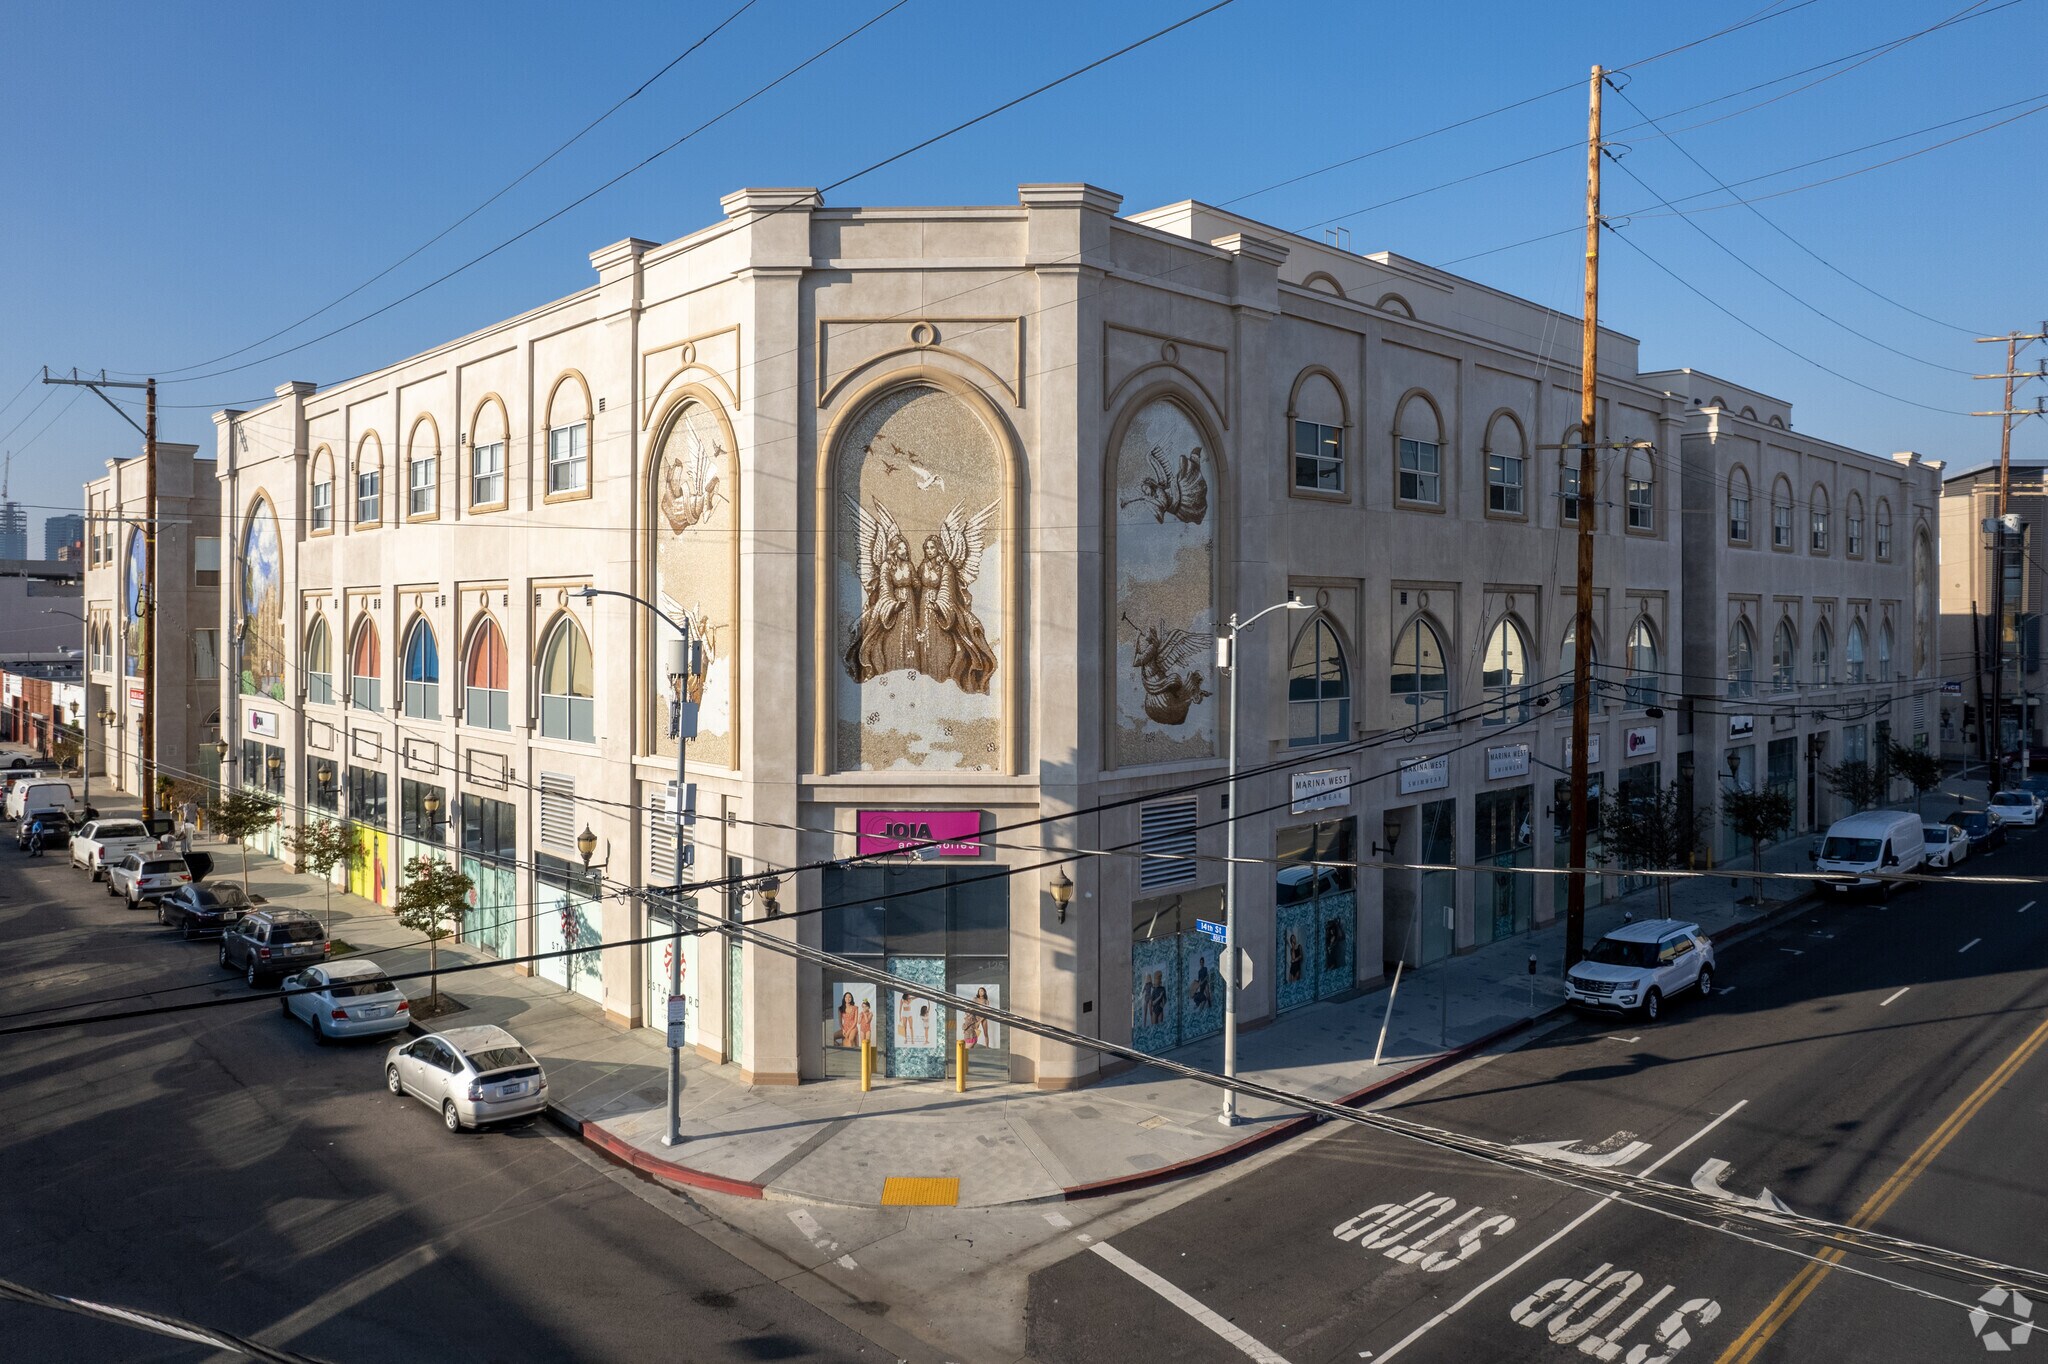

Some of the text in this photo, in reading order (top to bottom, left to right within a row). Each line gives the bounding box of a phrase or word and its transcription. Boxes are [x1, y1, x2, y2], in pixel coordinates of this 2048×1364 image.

[1490, 752, 1511, 760] MARINA
[1430, 760, 1446, 769] WEST
[1295, 775, 1348, 790] MARINA WEST
[1408, 776, 1441, 787] SWIMWEAR
[879, 823, 933, 839] JOIA
[1200, 922, 1222, 934] 14th St
[1333, 1191, 1516, 1272] STOP
[1510, 1262, 1721, 1364] STOP
